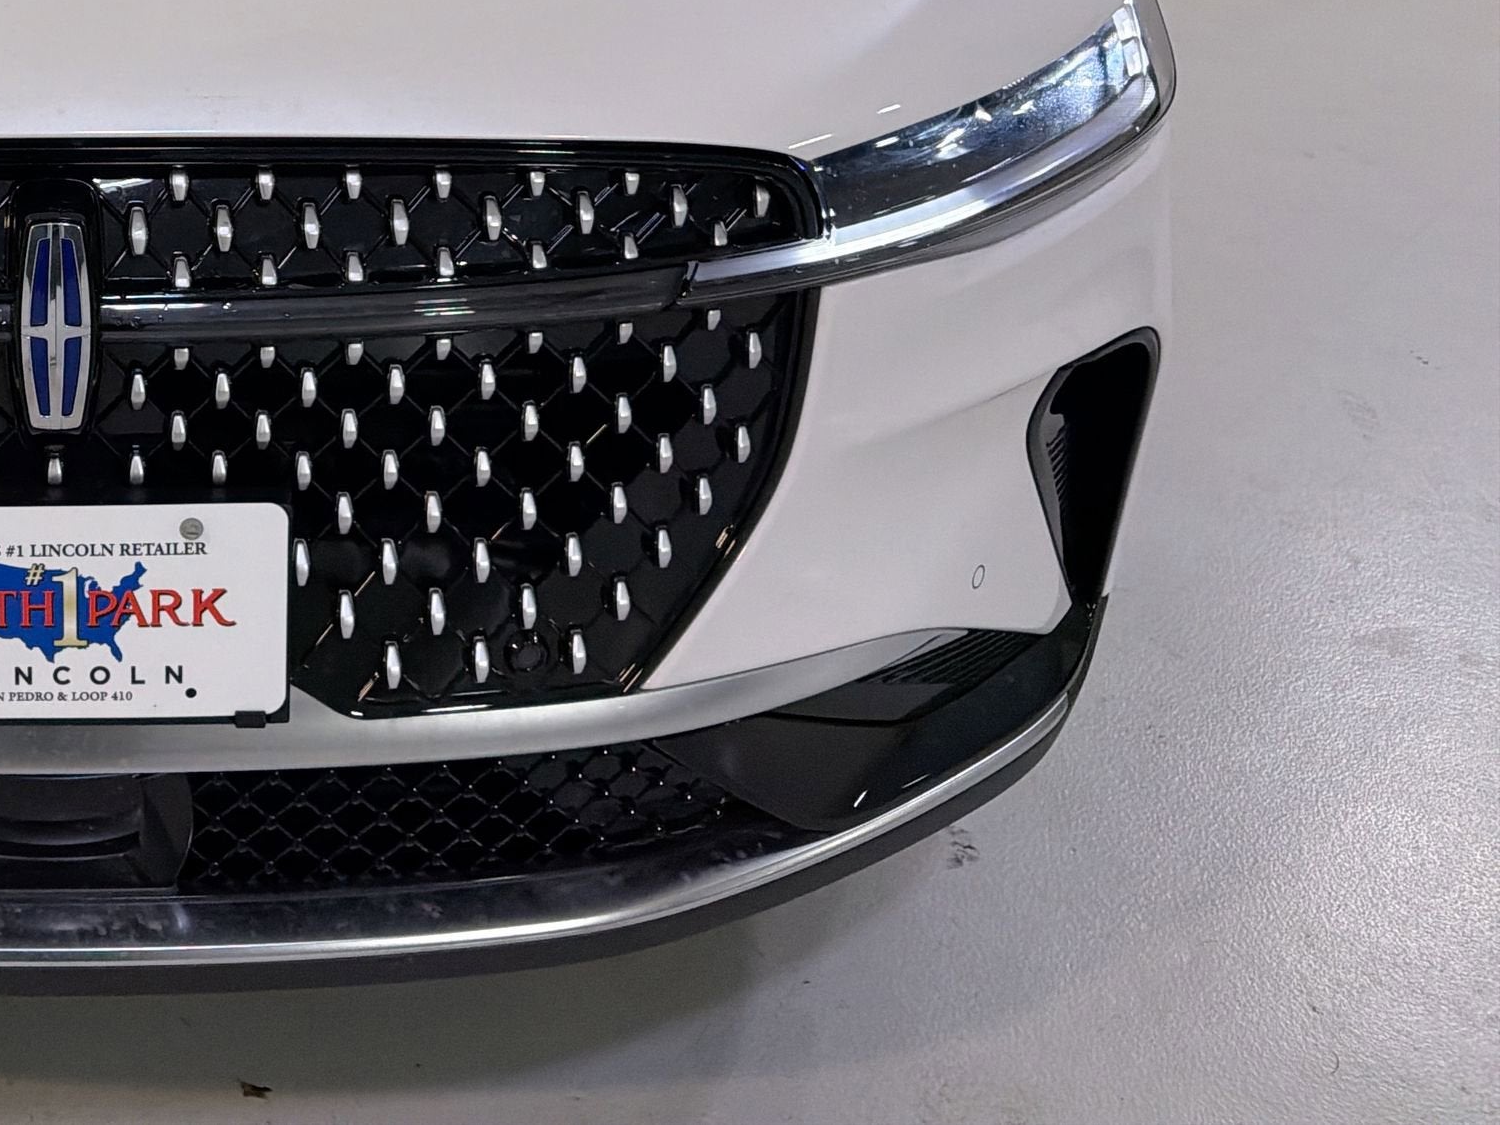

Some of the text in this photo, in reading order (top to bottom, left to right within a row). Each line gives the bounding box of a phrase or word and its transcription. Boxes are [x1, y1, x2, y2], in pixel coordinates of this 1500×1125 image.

[5, 544, 24, 557] #1
[30, 543, 115, 557] LINCOLN
[119, 541, 208, 557] RETAILER
[87, 587, 237, 628] PARK
[8, 691, 54, 702] PEDRO
[57, 691, 68, 702] &
[71, 691, 109, 702] LOOP
[111, 690, 134, 702] 410
